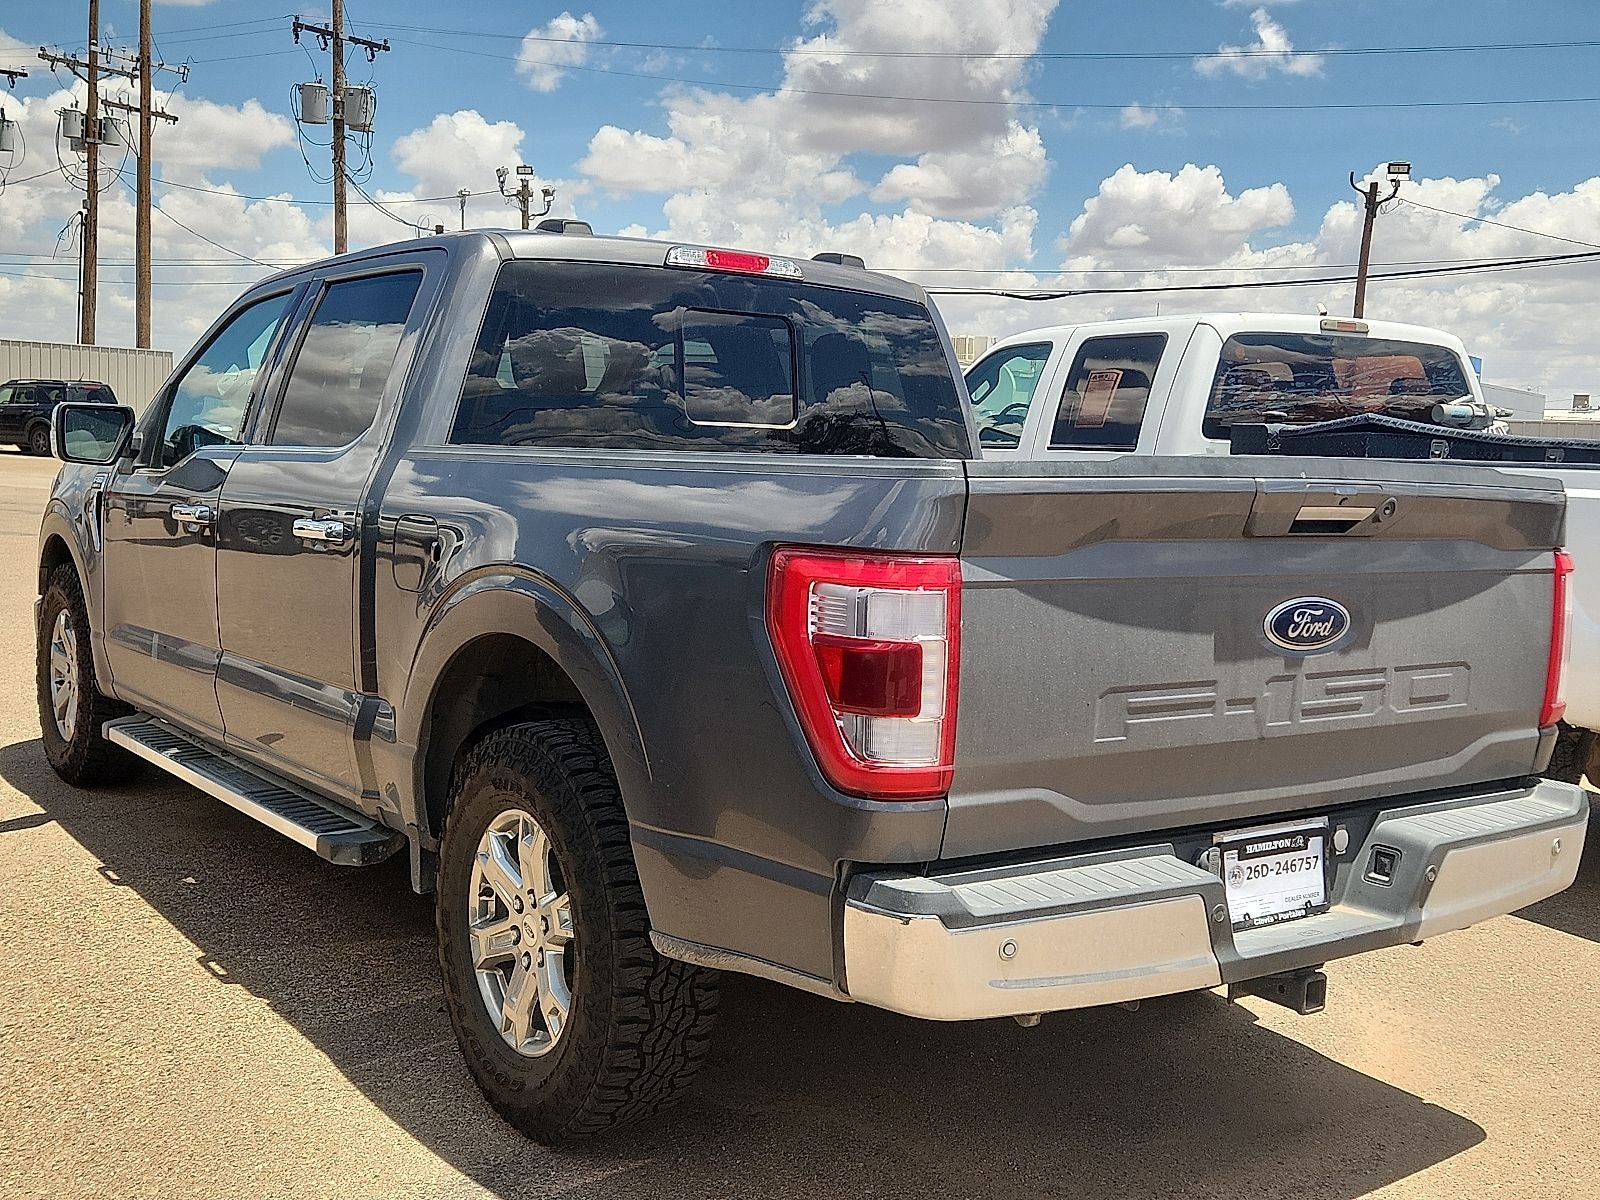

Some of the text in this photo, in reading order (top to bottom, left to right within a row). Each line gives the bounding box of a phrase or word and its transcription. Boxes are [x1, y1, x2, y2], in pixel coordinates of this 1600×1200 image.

[1287, 608, 1335, 639] Ford
[1094, 661, 1472, 743] F-150
[1246, 839, 1291, 853] HAMILTON
[1246, 855, 1319, 880] 26D-246757
